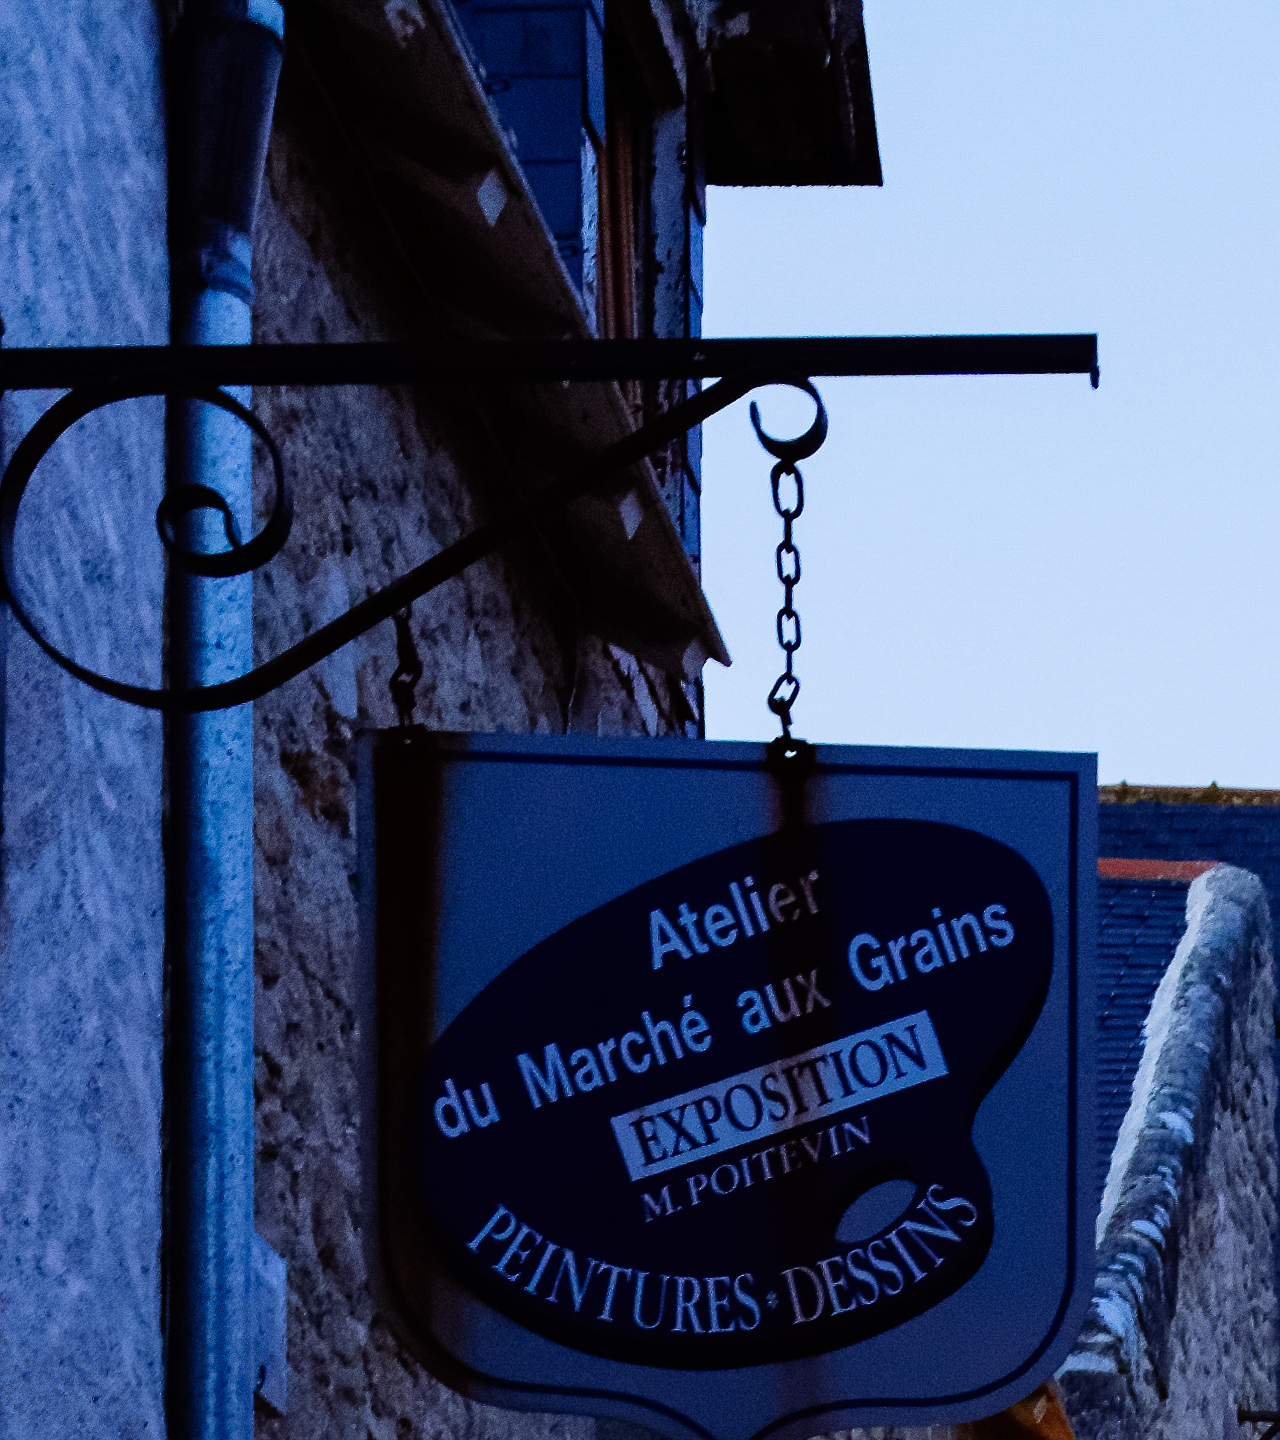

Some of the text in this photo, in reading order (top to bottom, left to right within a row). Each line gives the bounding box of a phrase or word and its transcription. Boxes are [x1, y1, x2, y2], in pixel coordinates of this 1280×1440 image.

[649, 870, 820, 969] Atelier
[433, 903, 1014, 1139] du Marché aux Grains
[629, 1026, 929, 1167] EXPOSITION
[686, 1114, 872, 1206] POITEVIN
